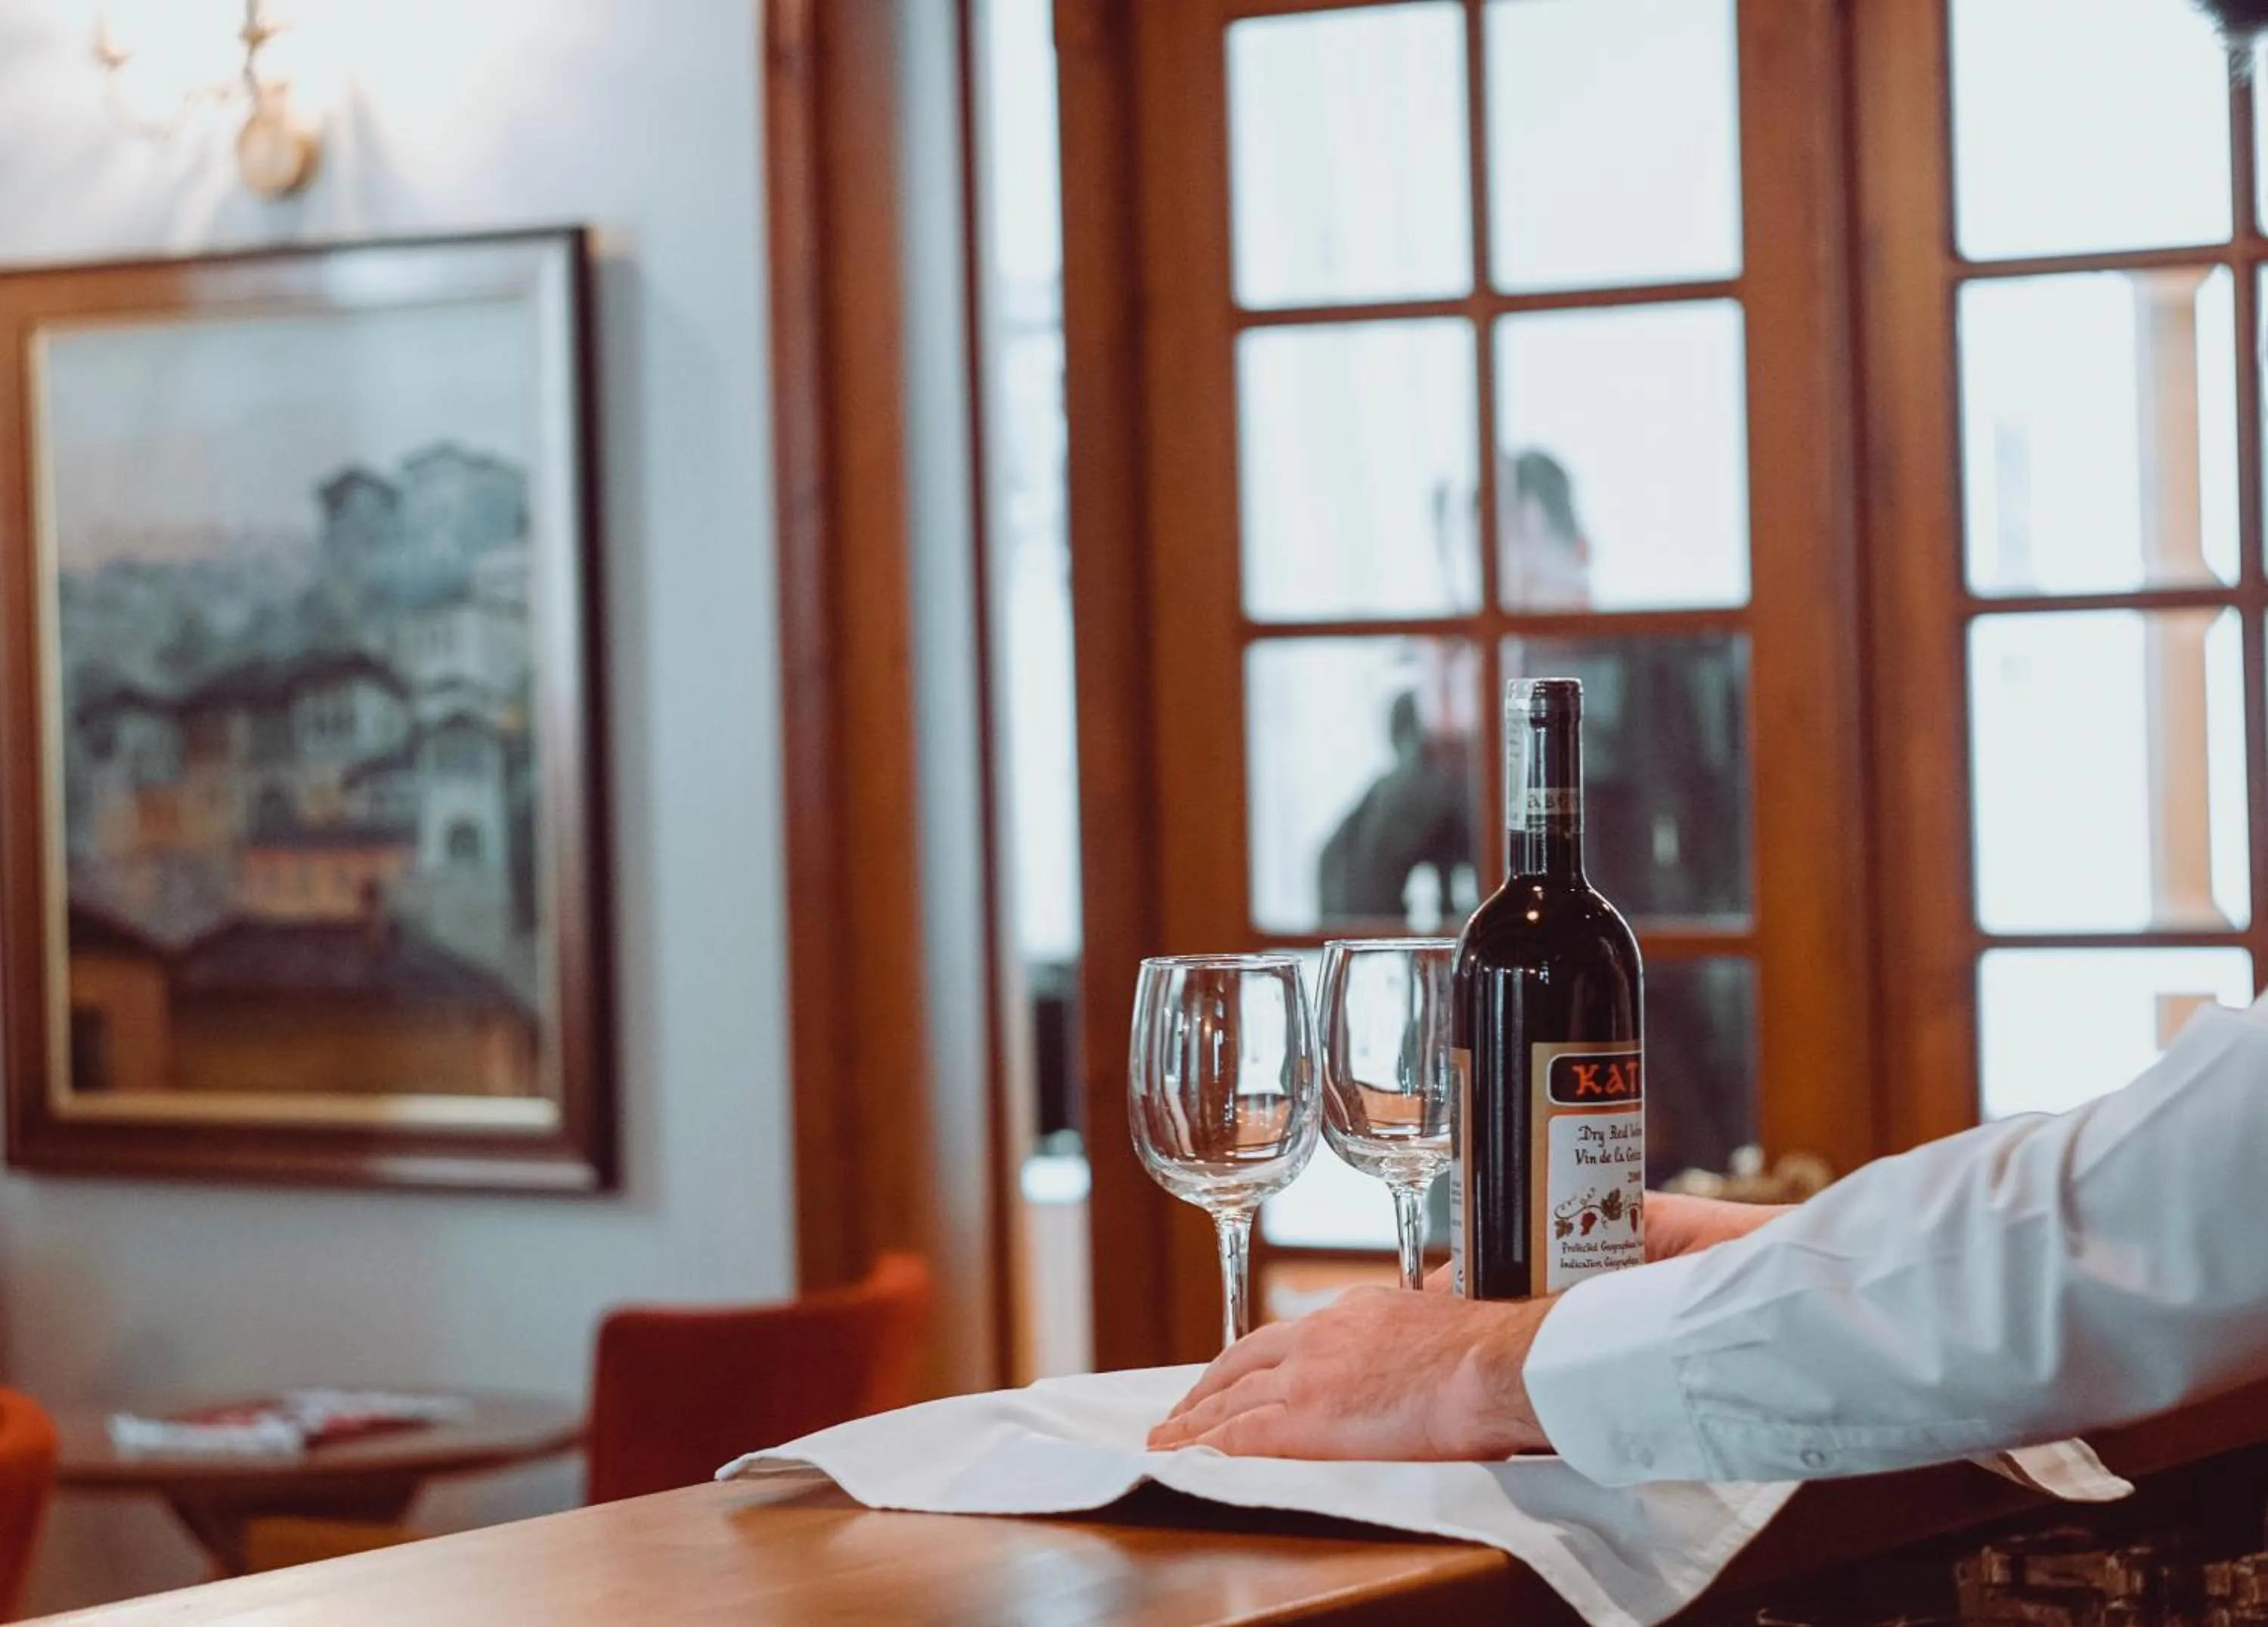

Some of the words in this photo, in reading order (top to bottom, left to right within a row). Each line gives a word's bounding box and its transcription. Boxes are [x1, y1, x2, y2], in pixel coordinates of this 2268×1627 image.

[1578, 1124, 1605, 1148] Dry
[1609, 1124, 1628, 1139] Red
[1575, 1148, 1597, 1165] Vin
[1599, 1148, 1611, 1164] de
[1614, 1146, 1625, 1163] la
[1560, 1257, 1603, 1269] Indication
